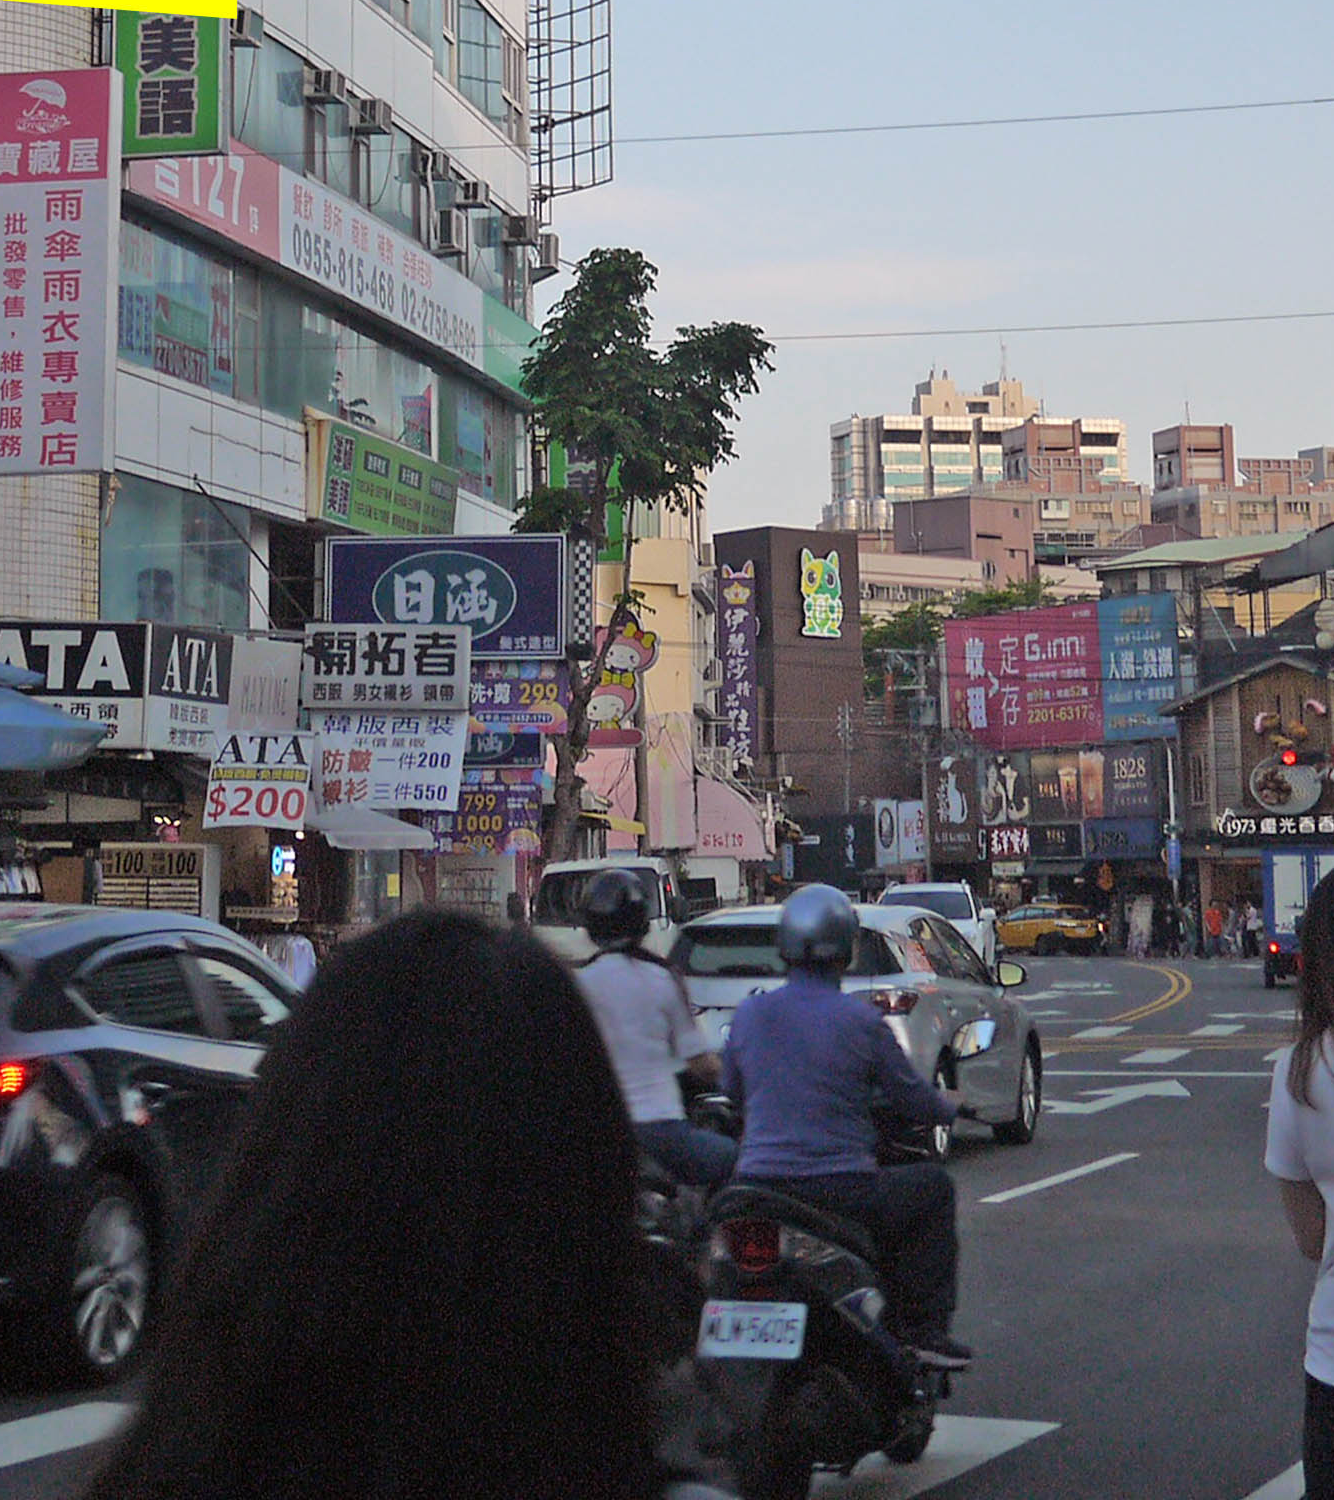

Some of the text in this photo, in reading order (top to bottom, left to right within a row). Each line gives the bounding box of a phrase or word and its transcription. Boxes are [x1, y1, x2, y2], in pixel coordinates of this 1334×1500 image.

[38, 187, 83, 468] 雨傘雨衣專賣店
[161, 633, 220, 698] ATA
[309, 631, 457, 677] 開拓者
[518, 683, 558, 705] 299
[323, 714, 456, 736] 韓版西裝
[214, 734, 308, 765] ATA
[1113, 757, 1146, 780] 1828
[207, 783, 305, 822] $200
[463, 794, 497, 812] 799
